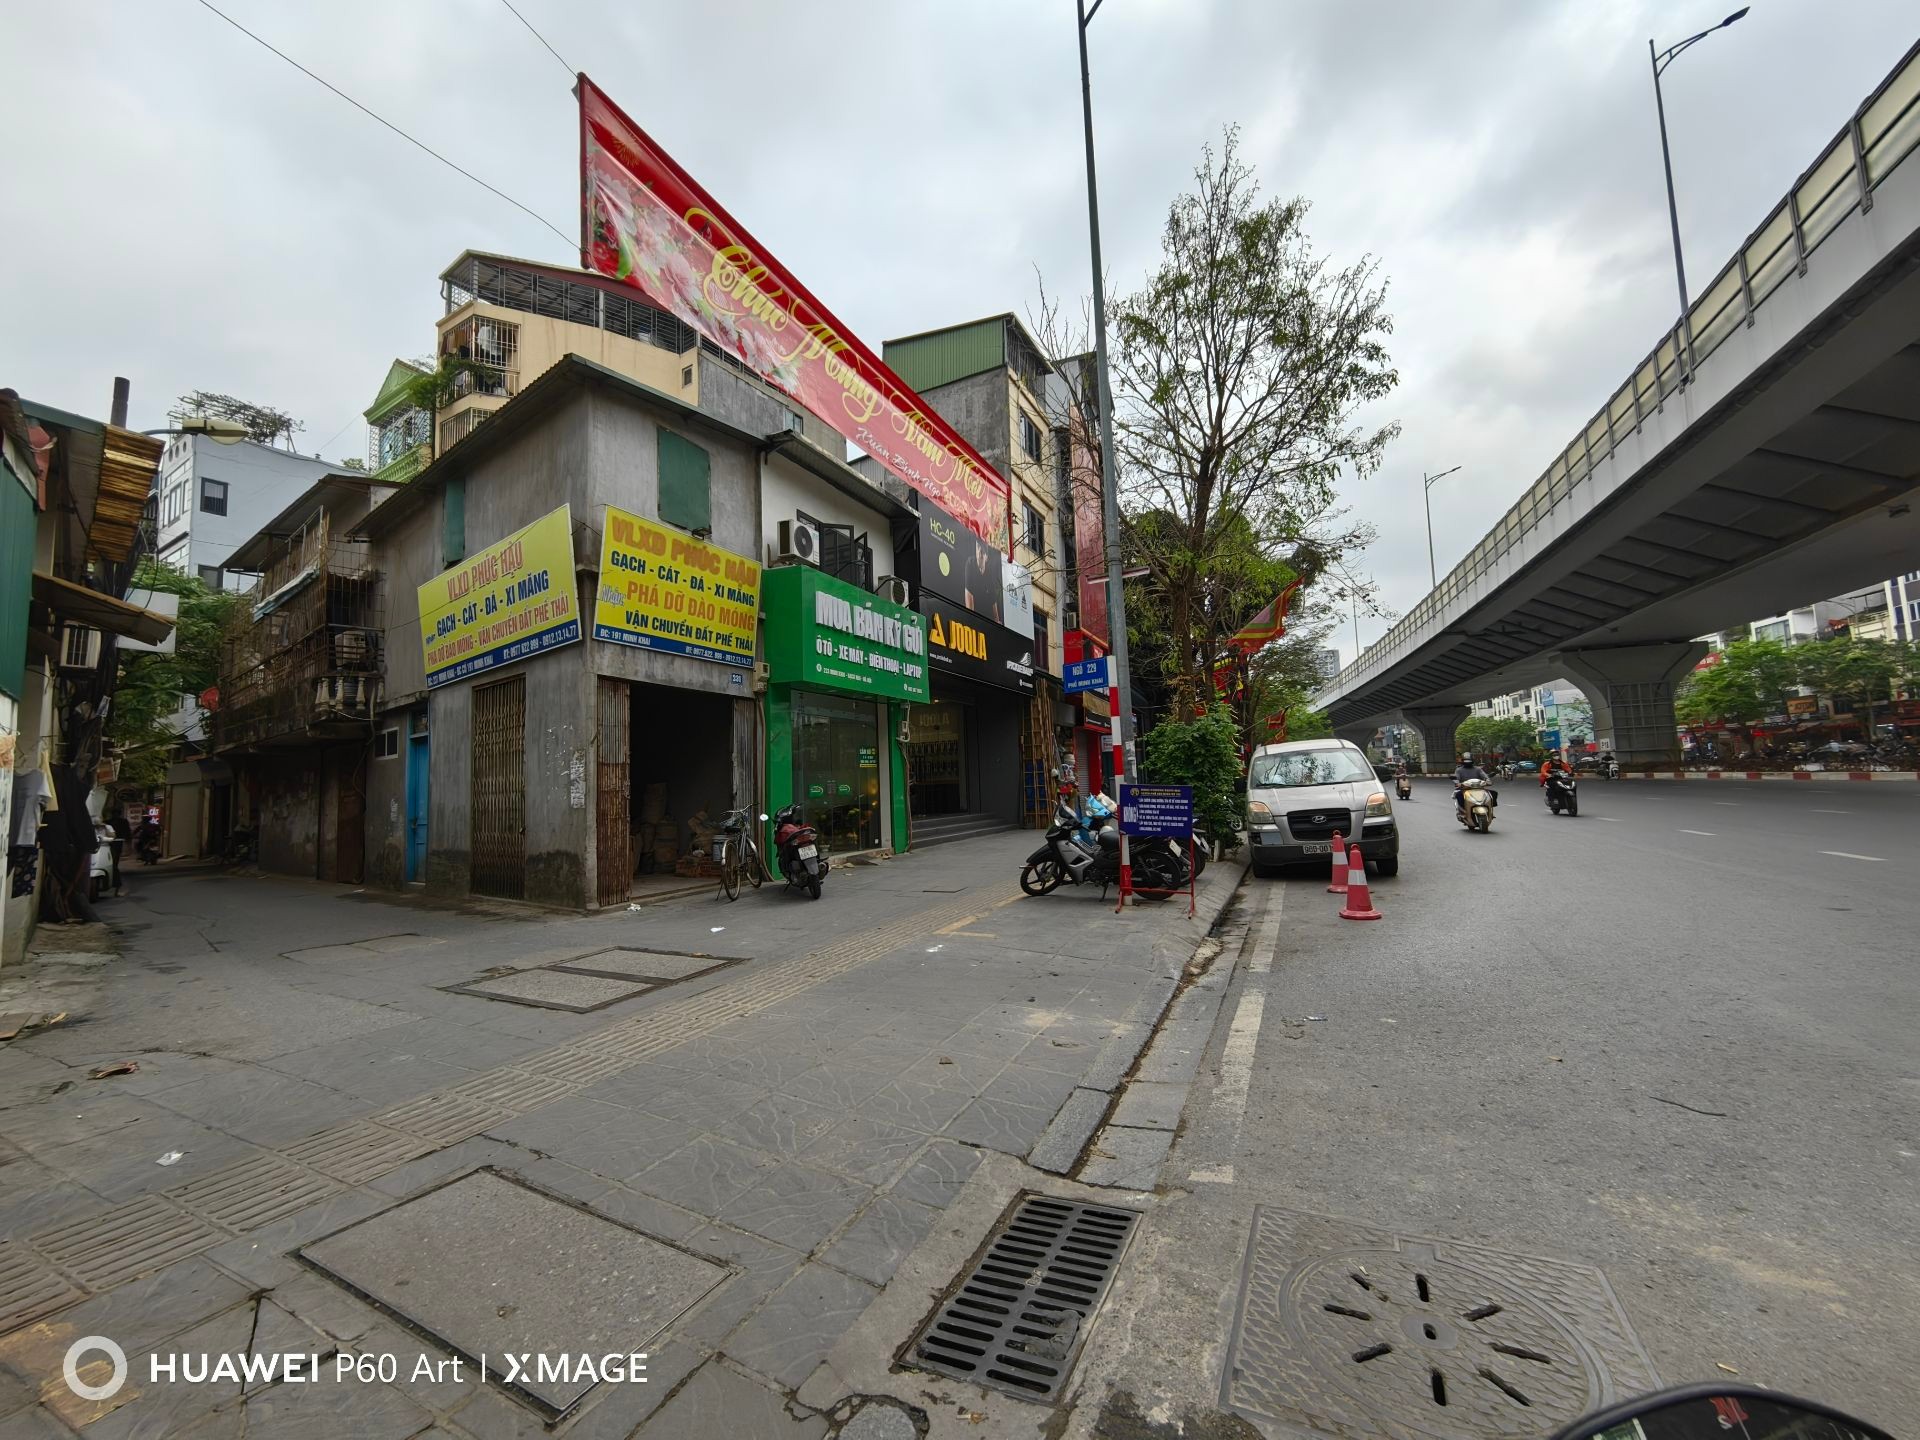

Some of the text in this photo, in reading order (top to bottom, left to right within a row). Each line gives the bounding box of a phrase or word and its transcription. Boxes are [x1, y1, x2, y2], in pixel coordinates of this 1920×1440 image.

[684, 207, 990, 513] Chúc Mừng Năm Mới
[612, 516, 758, 588] VLXD PHÚC HẬU
[930, 517, 955, 545] HC-40
[447, 541, 524, 601] VLXD PHÚC HẬU
[611, 551, 646, 574] GẠCH
[657, 565, 681, 585] CÁT
[690, 575, 704, 593] ĐÁ
[714, 583, 725, 598] XI
[727, 584, 755, 607] MĂNG
[427, 648, 438, 667] PHÁ
[445, 639, 457, 661] ĐÀO
[457, 634, 474, 658] MÓNG
[478, 626, 492, 650] VẬN
[491, 614, 519, 642] CHUYỂN
[519, 607, 533, 634] ĐẤT
[534, 601, 550, 626] PHẾ
[551, 590, 569, 618] THẢI
[436, 612, 457, 640] GẠCH
[462, 600, 477, 626] CÁT
[485, 590, 497, 614] ĐÁ
[505, 585, 516, 607] XI
[518, 569, 550, 602] MĂNG
[625, 609, 754, 652] VẬN CHUYỂN ĐẤT PHẾ THẢI
[626, 580, 660, 607] PHÁ
[664, 590, 685, 614] DỠ
[688, 597, 716, 622] ĐÀO
[719, 606, 755, 632] MÓNG
[816, 590, 924, 656] MUA BÁN KÝ GỬI
[611, 631, 621, 640] 191
[622, 633, 638, 645] MINH
[637, 635, 651, 646] KHAI
[838, 645, 848, 661] XE
[849, 645, 864, 665] MÁY
[869, 651, 884, 672] ĐIỆN
[883, 656, 900, 677] THOẠI
[903, 662, 923, 679] LAPTOP
[949, 620, 988, 661] JOOLA
[1091, 677, 1104, 685] KHAI
